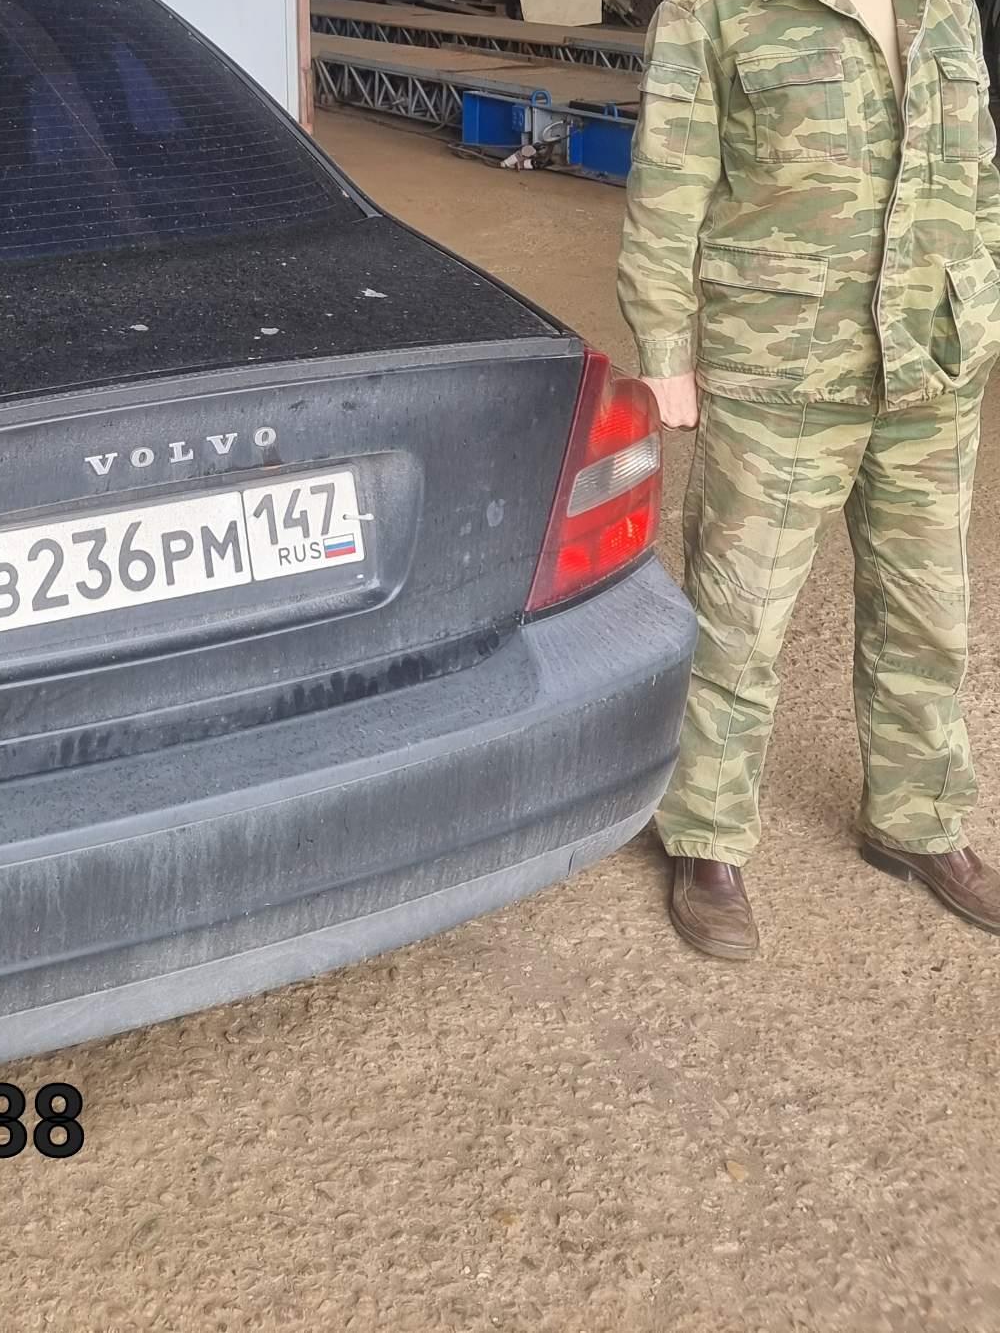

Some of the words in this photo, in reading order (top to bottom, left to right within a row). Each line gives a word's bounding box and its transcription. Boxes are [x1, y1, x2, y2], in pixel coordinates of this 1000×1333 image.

[84, 426, 277, 476] VOLVO
[253, 482, 336, 546] 147
[278, 542, 322, 566] RUS
